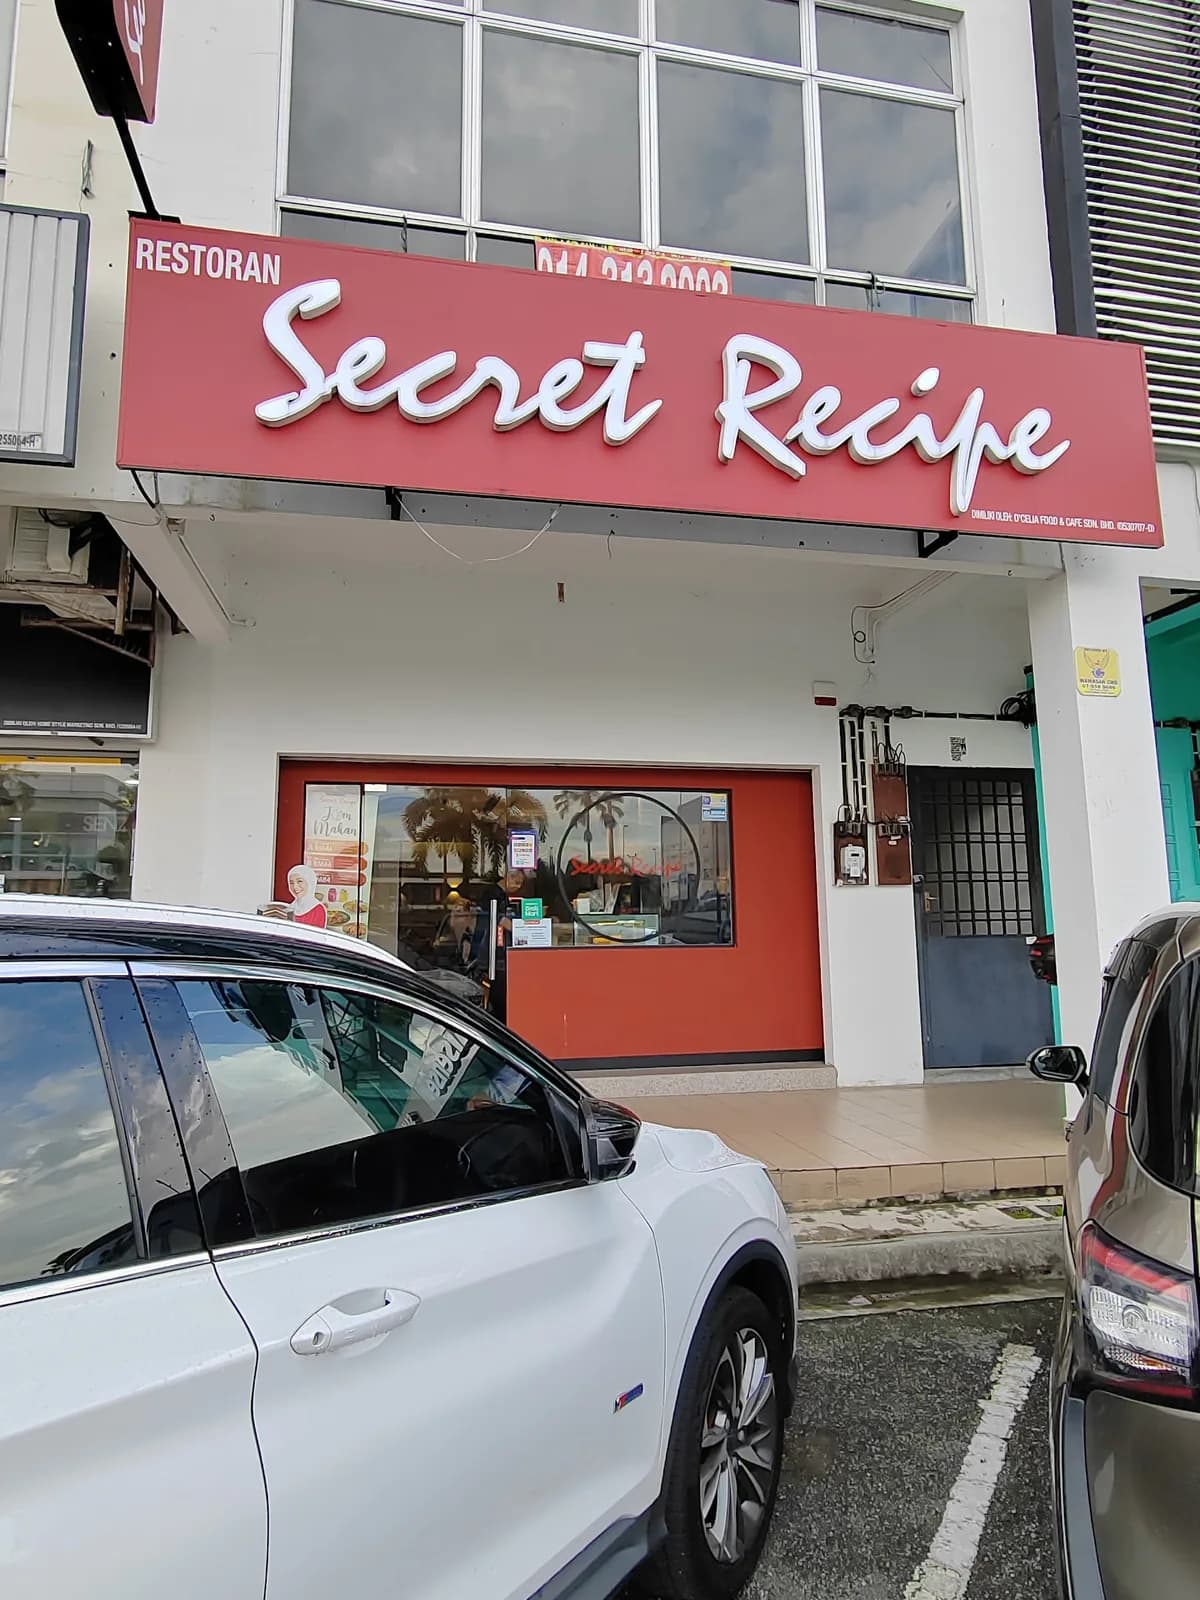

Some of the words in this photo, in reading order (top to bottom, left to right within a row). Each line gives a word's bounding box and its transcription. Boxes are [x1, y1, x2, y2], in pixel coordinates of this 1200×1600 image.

[135, 238, 281, 285] RESTORAN
[255, 278, 663, 446] Secret
[714, 334, 1071, 517] Recipe
[1040, 515, 1059, 526] FOOD
[1059, 516, 1065, 526] &
[1065, 517, 1083, 528] CAFE
